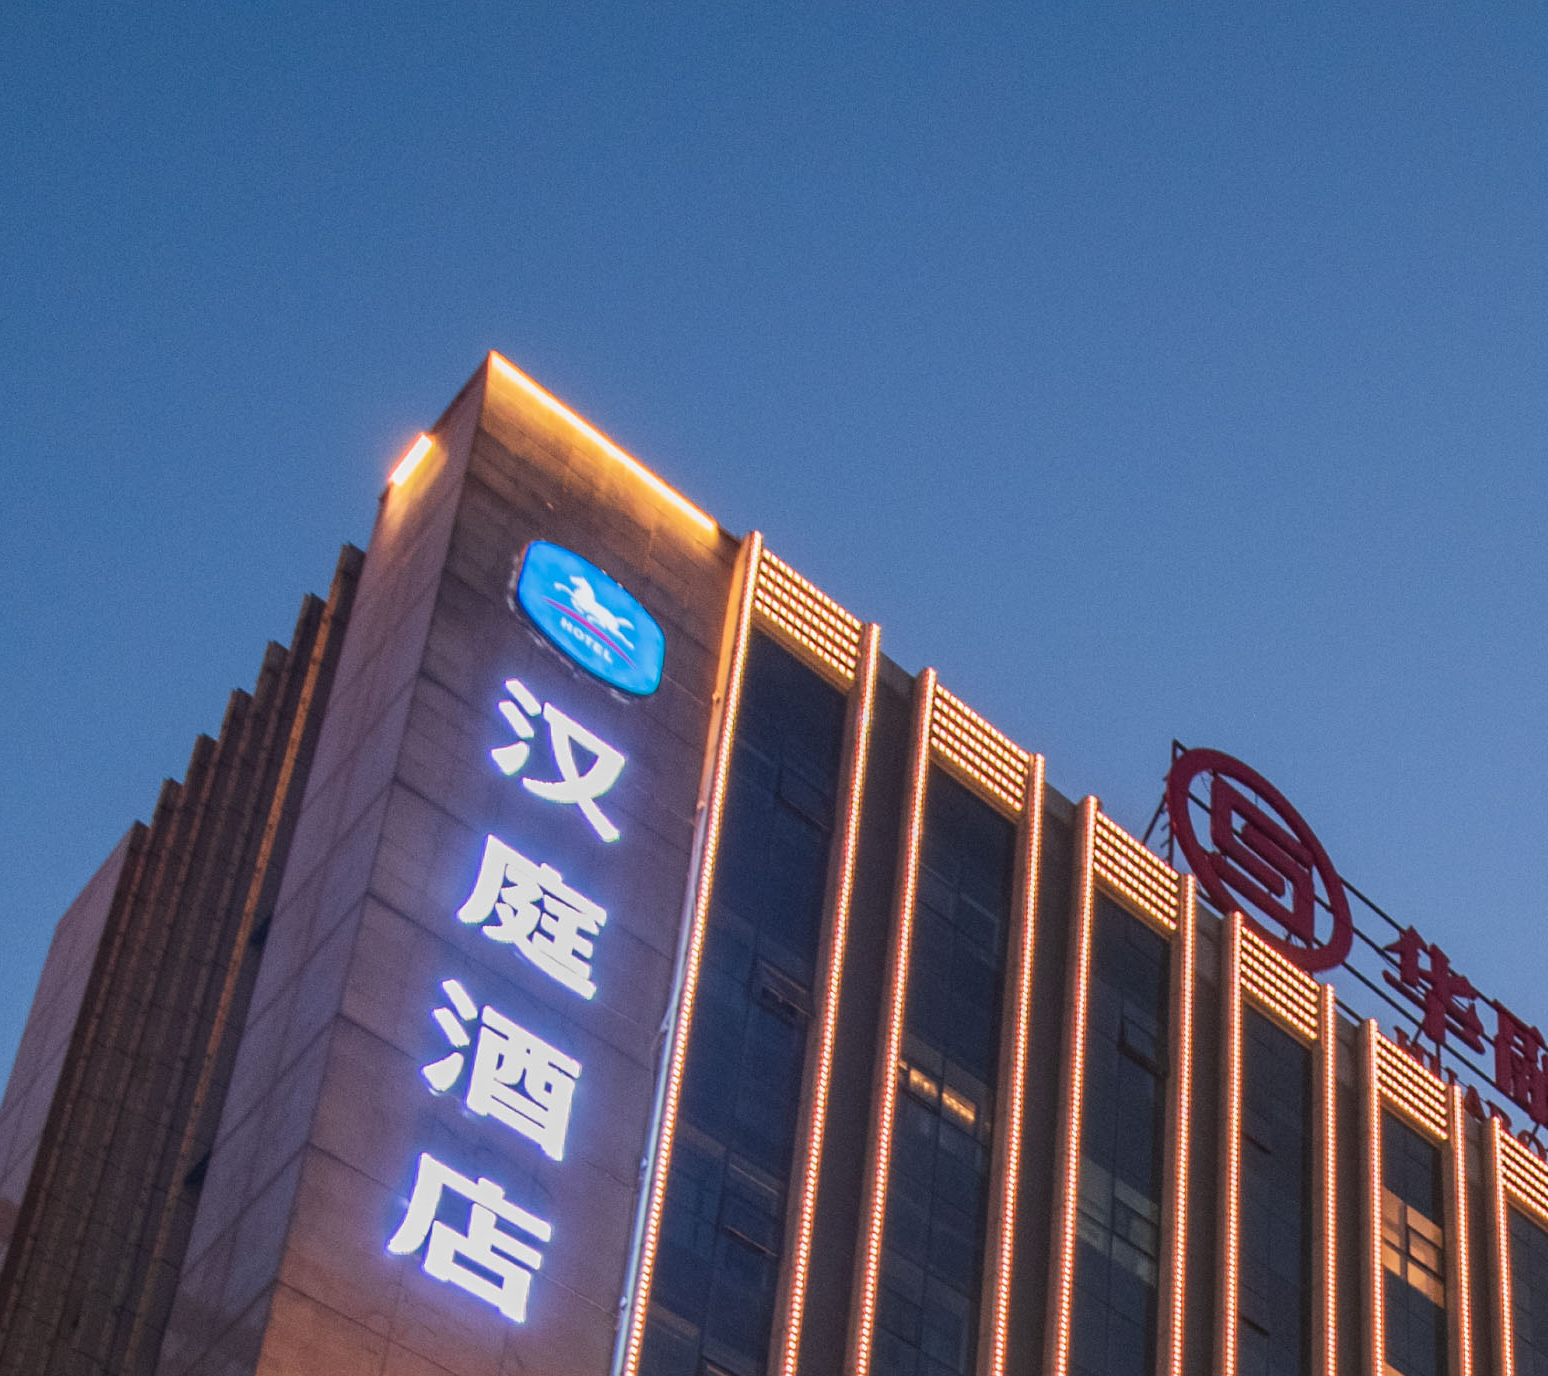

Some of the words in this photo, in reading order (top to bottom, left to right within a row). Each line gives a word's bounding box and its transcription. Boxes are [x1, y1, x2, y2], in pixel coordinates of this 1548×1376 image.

[560, 616, 613, 664] HOTEL
[386, 677, 628, 1325] 汉庭酒店
